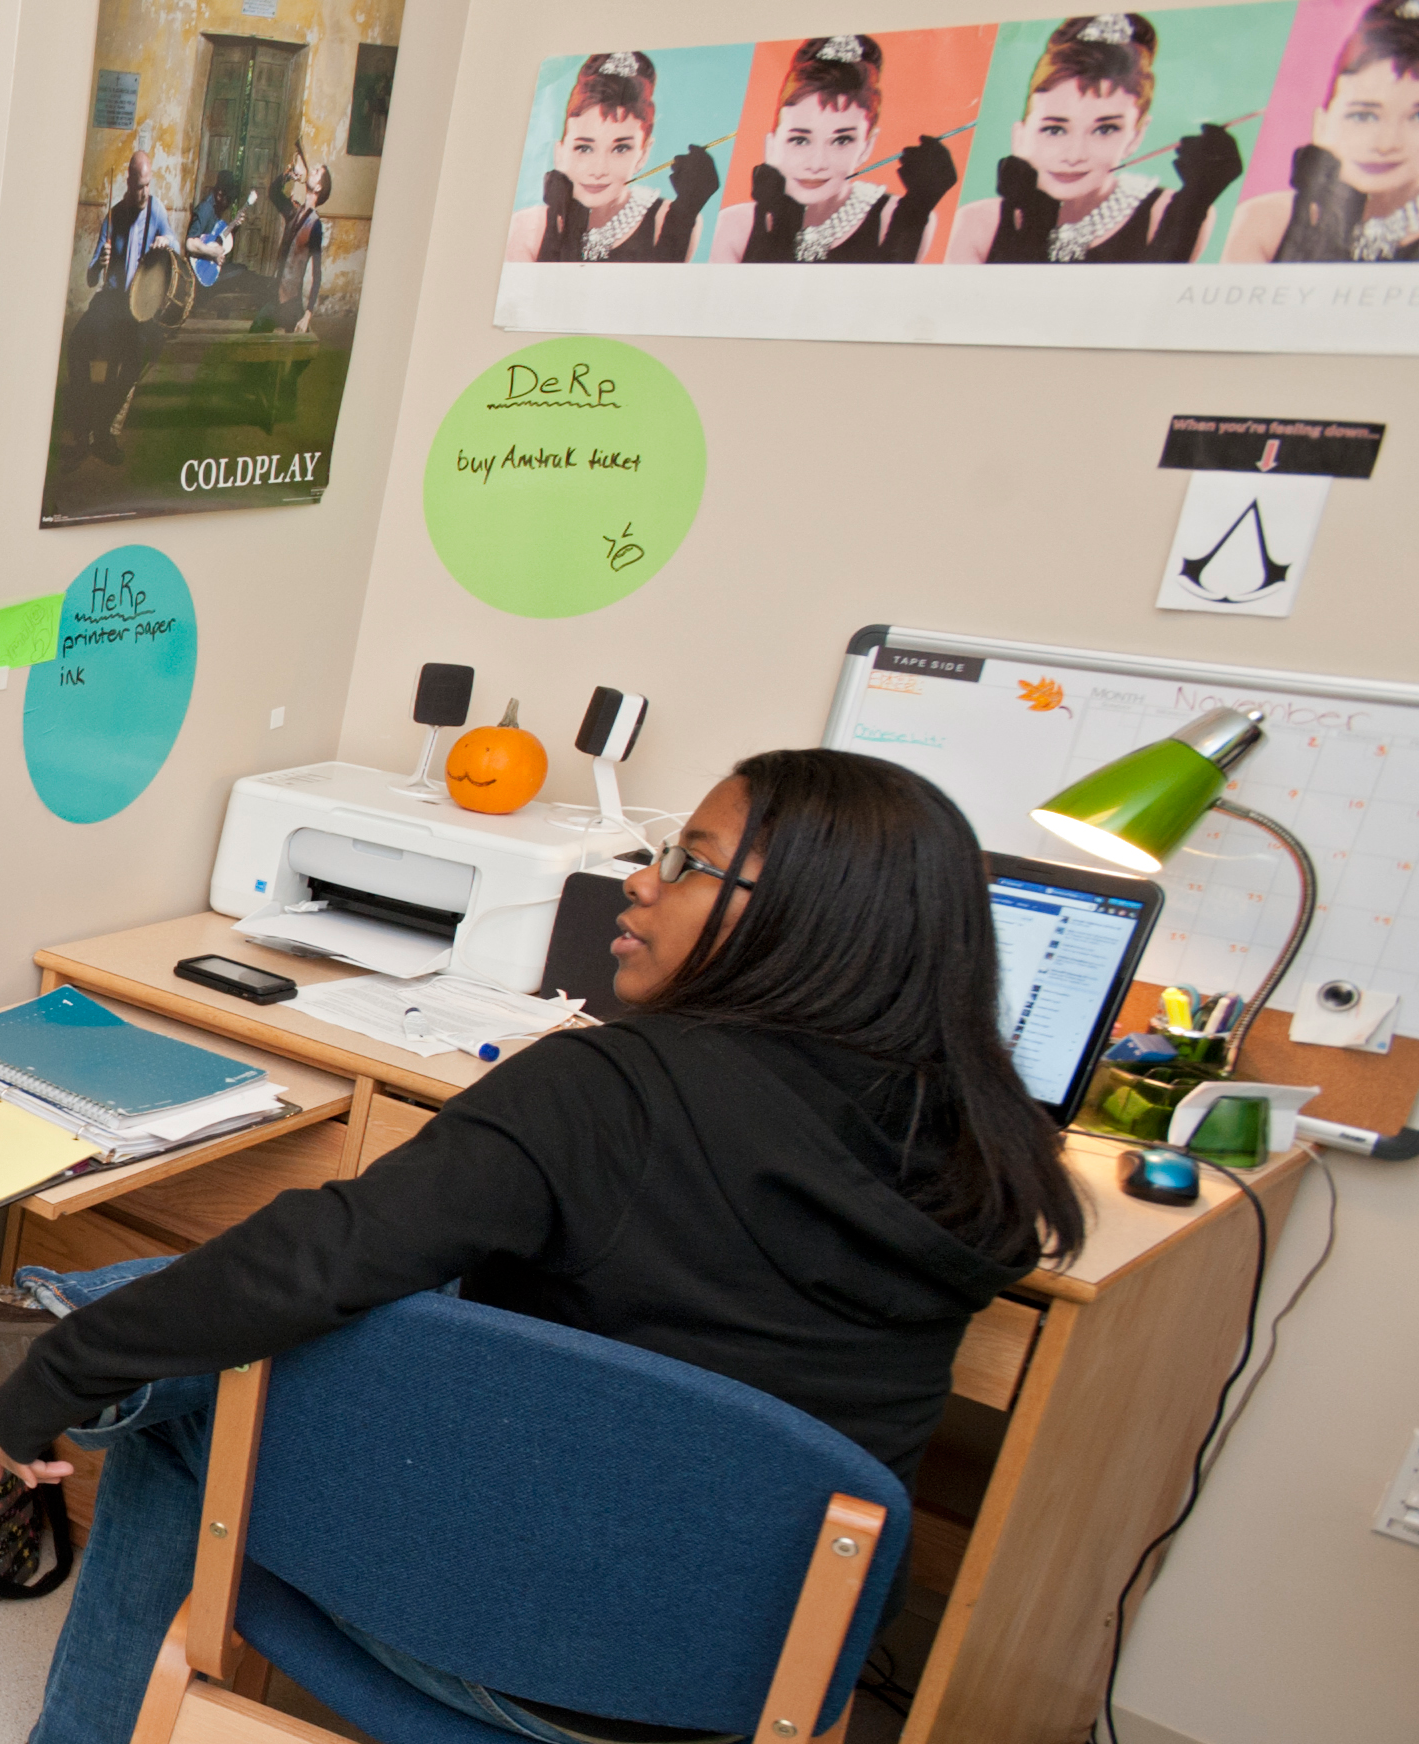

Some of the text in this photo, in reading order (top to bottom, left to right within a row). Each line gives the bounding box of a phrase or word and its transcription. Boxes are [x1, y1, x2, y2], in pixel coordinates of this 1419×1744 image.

[1176, 285, 1316, 307] AUDREY
[1172, 418, 1216, 432] When
[1219, 420, 1267, 435] you're
[1269, 421, 1323, 439] feeling
[180, 451, 322, 492] COLDPLAY
[457, 448, 497, 485] buy
[588, 448, 642, 472] ticket
[63, 627, 130, 658] printer
[134, 617, 176, 643] paper
[893, 655, 965, 673] TAPE SIDE
[60, 666, 86, 686] ink
[1091, 687, 1145, 703] MONTH
[1174, 686, 1372, 731] November
[1308, 737, 1320, 748] 2
[1374, 745, 1387, 757] 3
